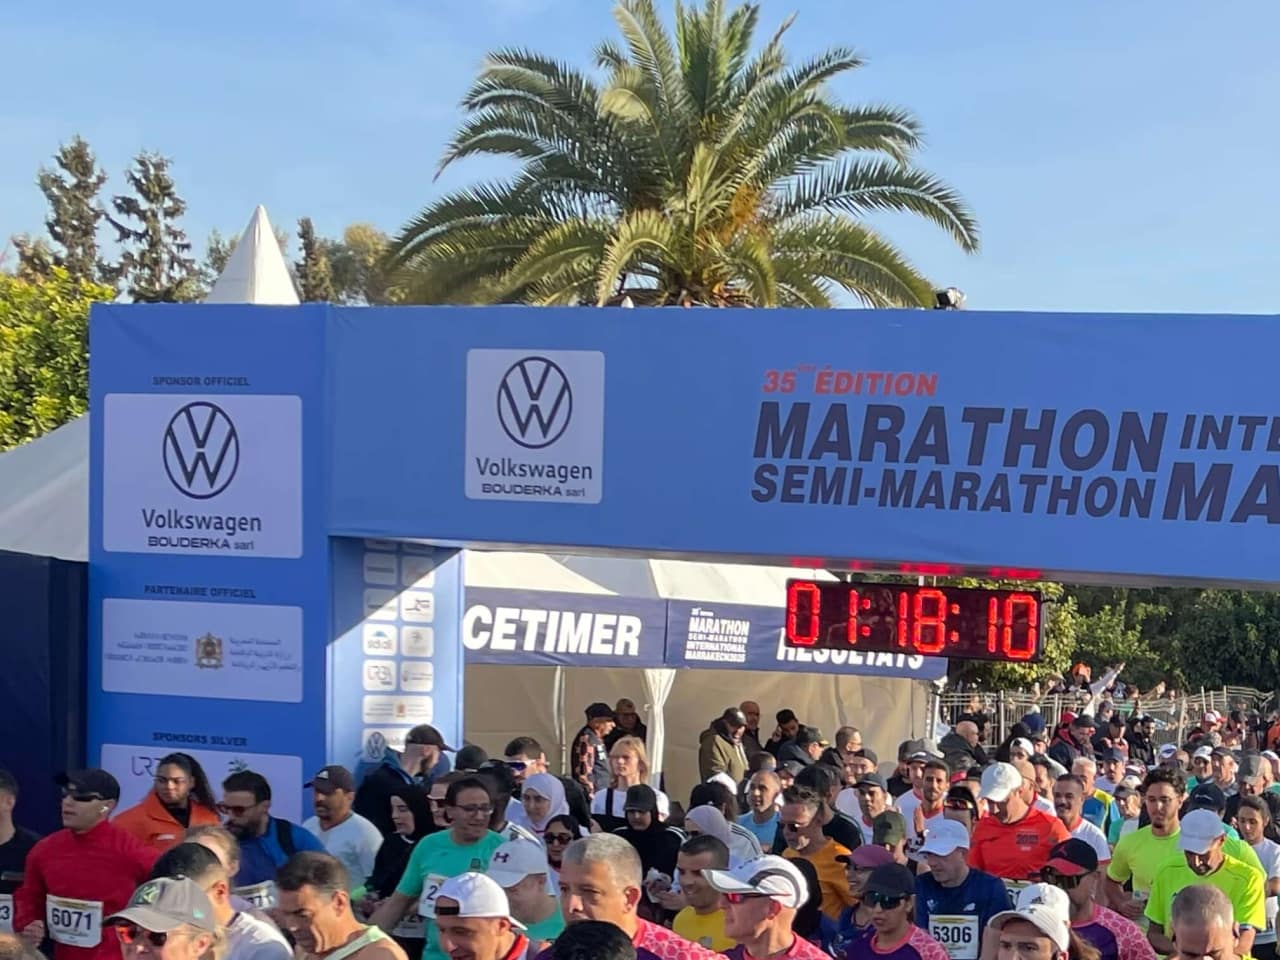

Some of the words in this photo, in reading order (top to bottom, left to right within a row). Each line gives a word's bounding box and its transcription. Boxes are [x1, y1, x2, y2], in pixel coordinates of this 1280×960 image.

[152, 375, 202, 386] SPONSOR
[204, 376, 251, 387] OFFICIEL
[814, 365, 938, 397] ÉDITION
[753, 400, 1168, 473] MARATHON
[476, 457, 593, 484] Volkswagen
[482, 483, 562, 496] BOUDERKA
[566, 488, 586, 498] sarl
[751, 463, 1156, 519] SEMI-MARATHON
[142, 508, 262, 537] Volkswagen
[148, 535, 231, 550] BOUDERKA
[234, 541, 255, 551] sarl
[144, 585, 207, 597] PARTENAIRE
[210, 587, 257, 599] OFFICIEL
[463, 605, 641, 656] CETIMER
[689, 617, 749, 636] MARATHON
[786, 582, 1038, 660] 01:18:10
[153, 731, 208, 744] SPONSORS
[211, 735, 248, 747] SILVER
[51, 907, 92, 931] 6071
[933, 926, 972, 944] 5306
